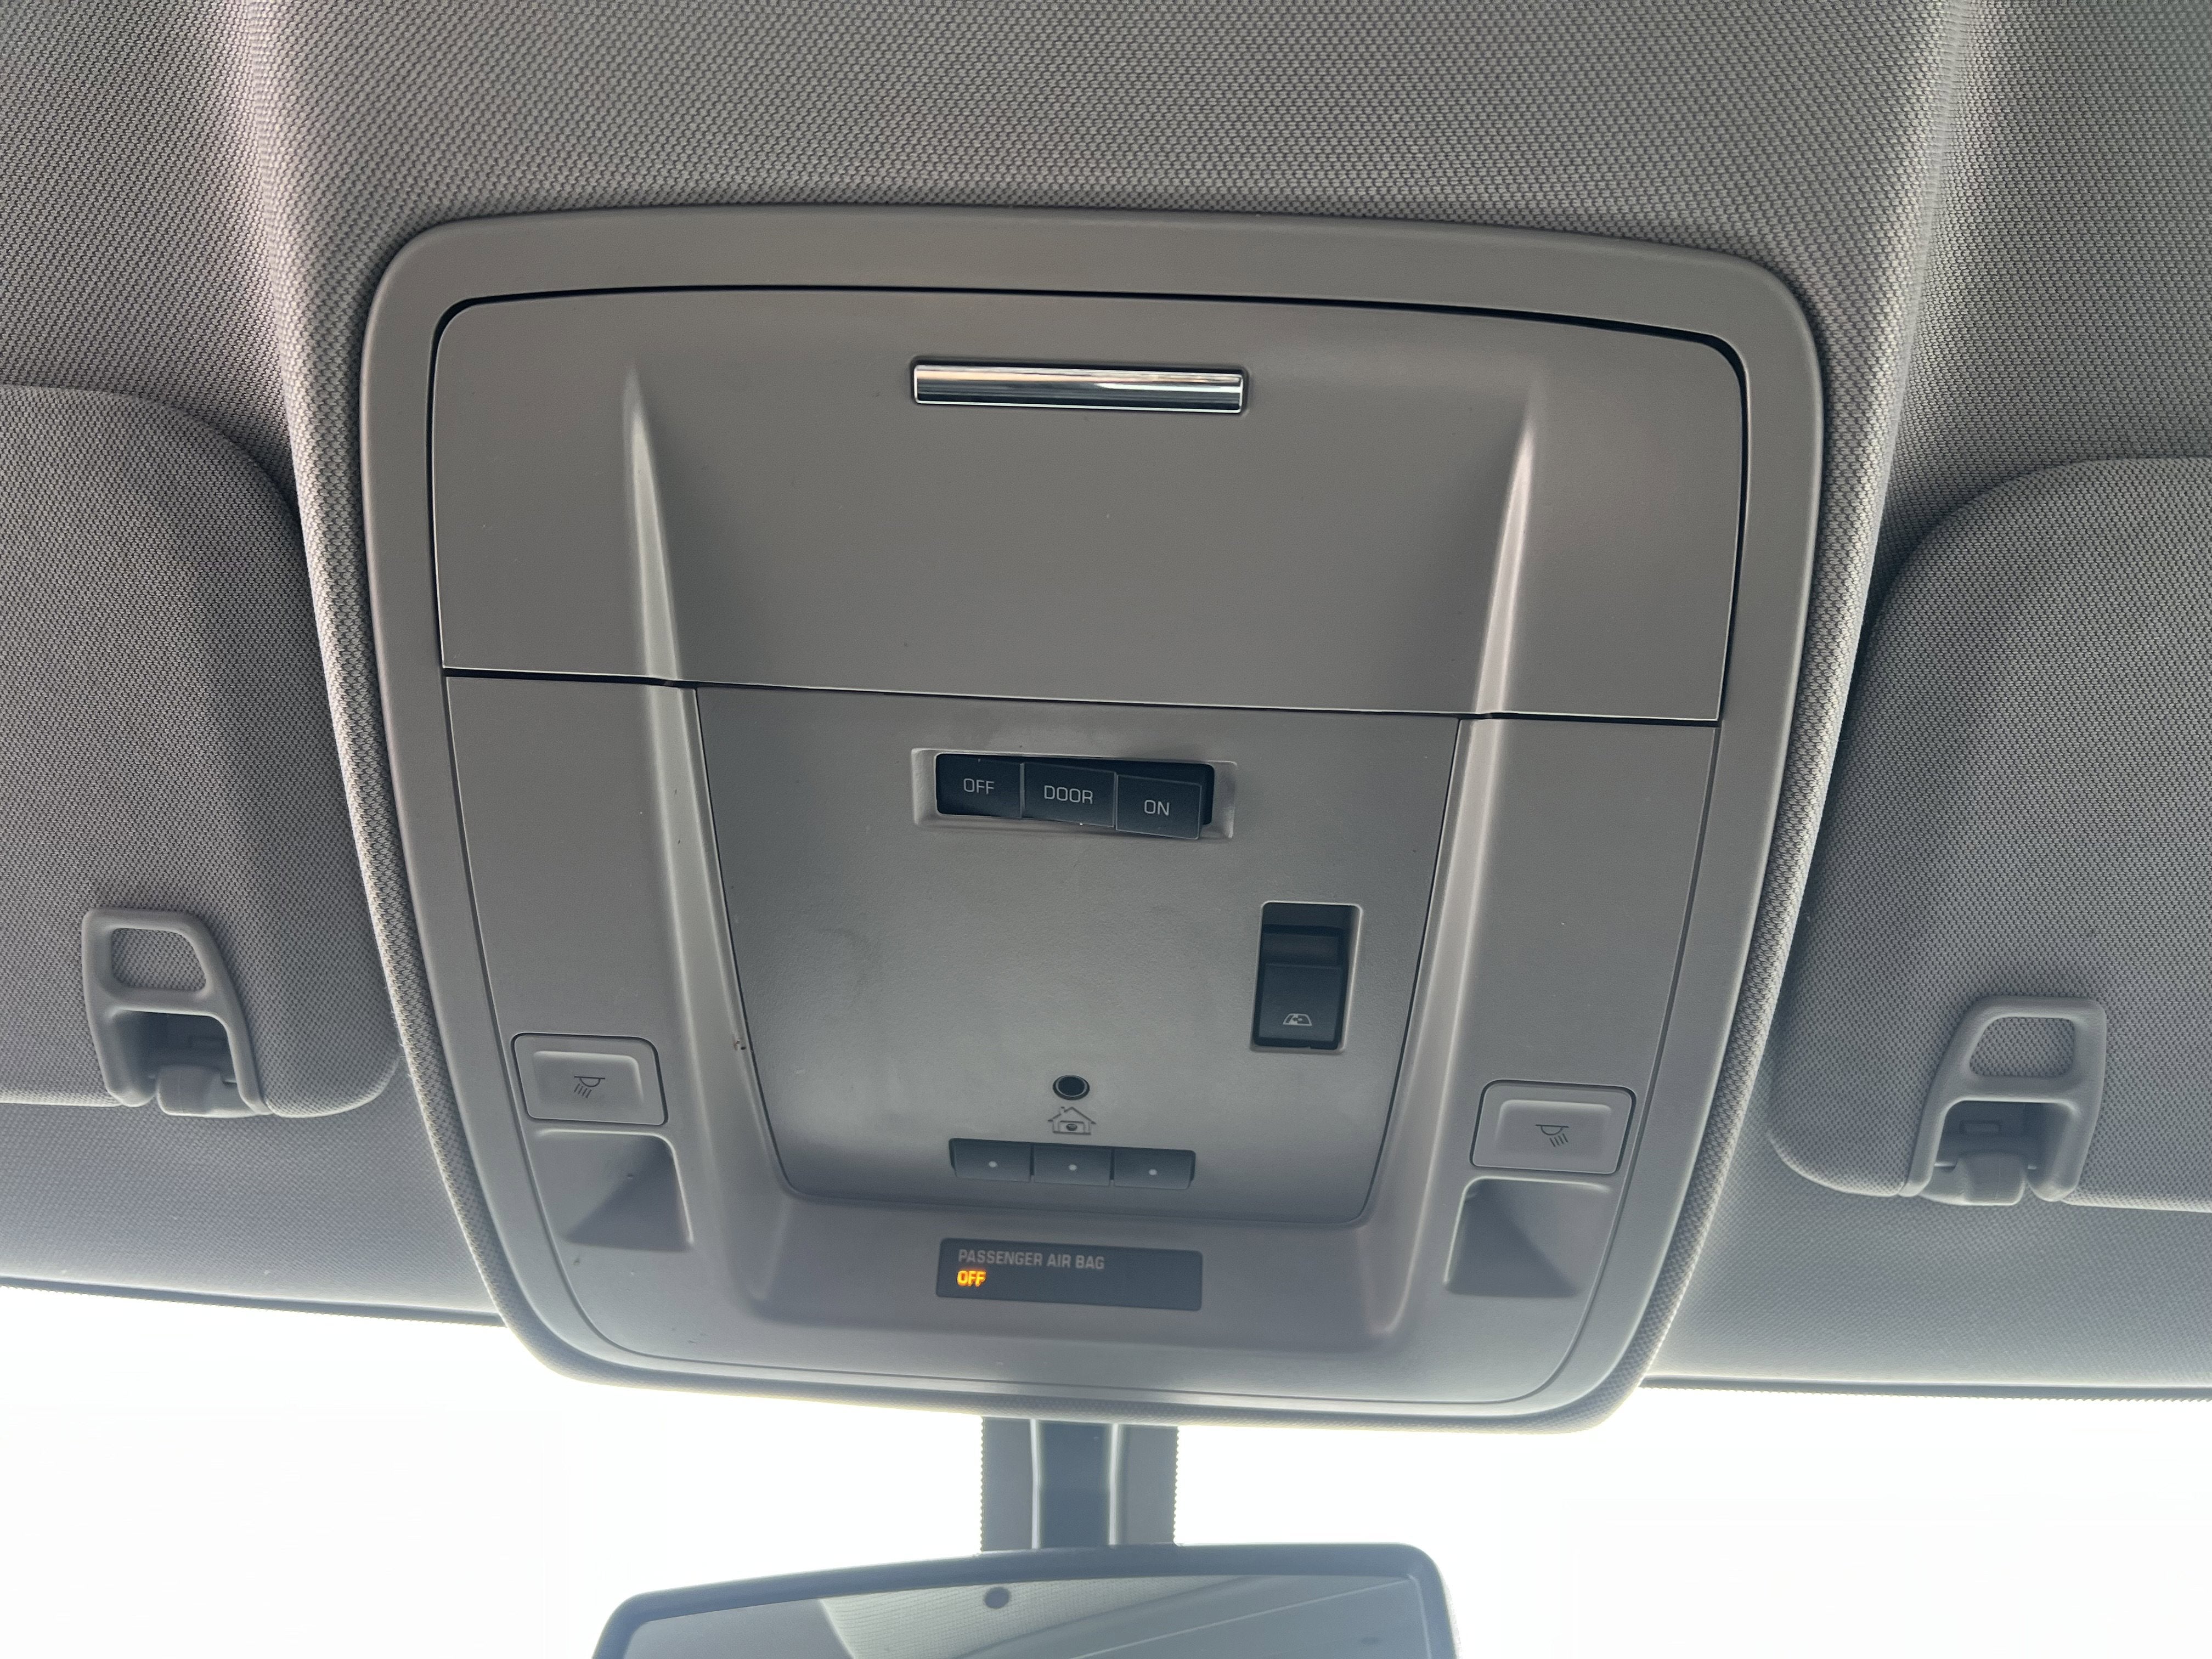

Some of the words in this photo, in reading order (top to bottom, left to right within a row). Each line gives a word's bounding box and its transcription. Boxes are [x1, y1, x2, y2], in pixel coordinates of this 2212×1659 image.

[963, 778, 995, 794] OFF
[1044, 785, 1093, 804] DOOR
[1144, 800, 1170, 816] ON
[958, 1249, 1043, 1267] PASSENGER
[1046, 1254, 1071, 1268] AIR
[1075, 1255, 1105, 1270] BAG
[957, 1270, 986, 1286] OFF
